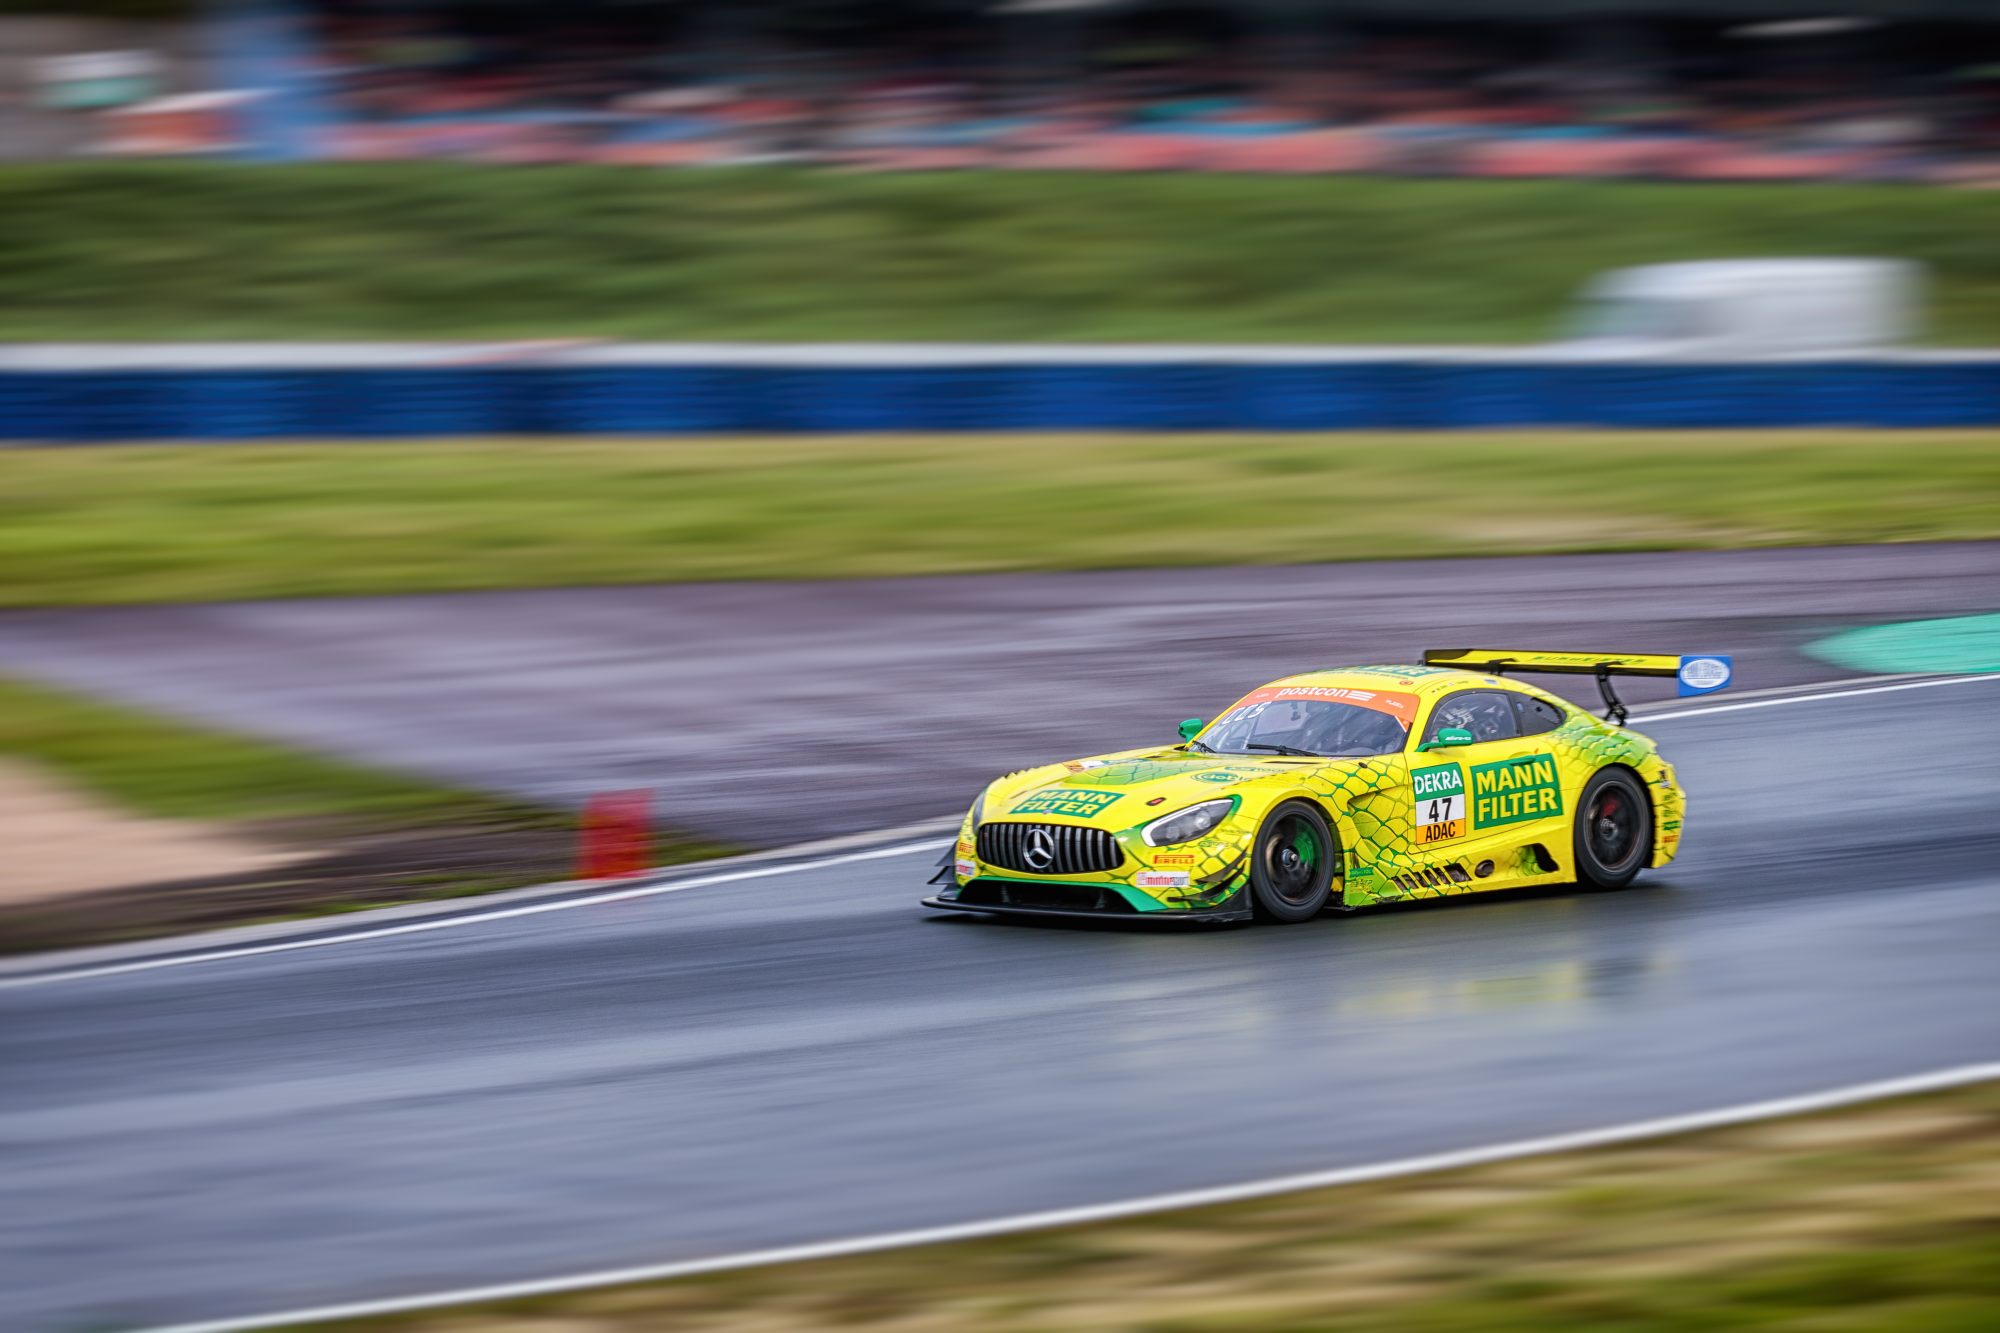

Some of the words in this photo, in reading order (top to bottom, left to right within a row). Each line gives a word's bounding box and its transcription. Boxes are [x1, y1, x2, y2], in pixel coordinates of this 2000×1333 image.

[1274, 687, 1349, 699] postcon
[1414, 769, 1463, 795] DEKRA
[1475, 760, 1554, 796] MANN
[1031, 791, 1118, 804] MANN
[1478, 787, 1558, 822] FILTER
[1015, 801, 1100, 815] FILTER
[1428, 797, 1452, 823] 47
[1425, 822, 1456, 842] ADAC
[1154, 855, 1195, 864] PIRELLI
